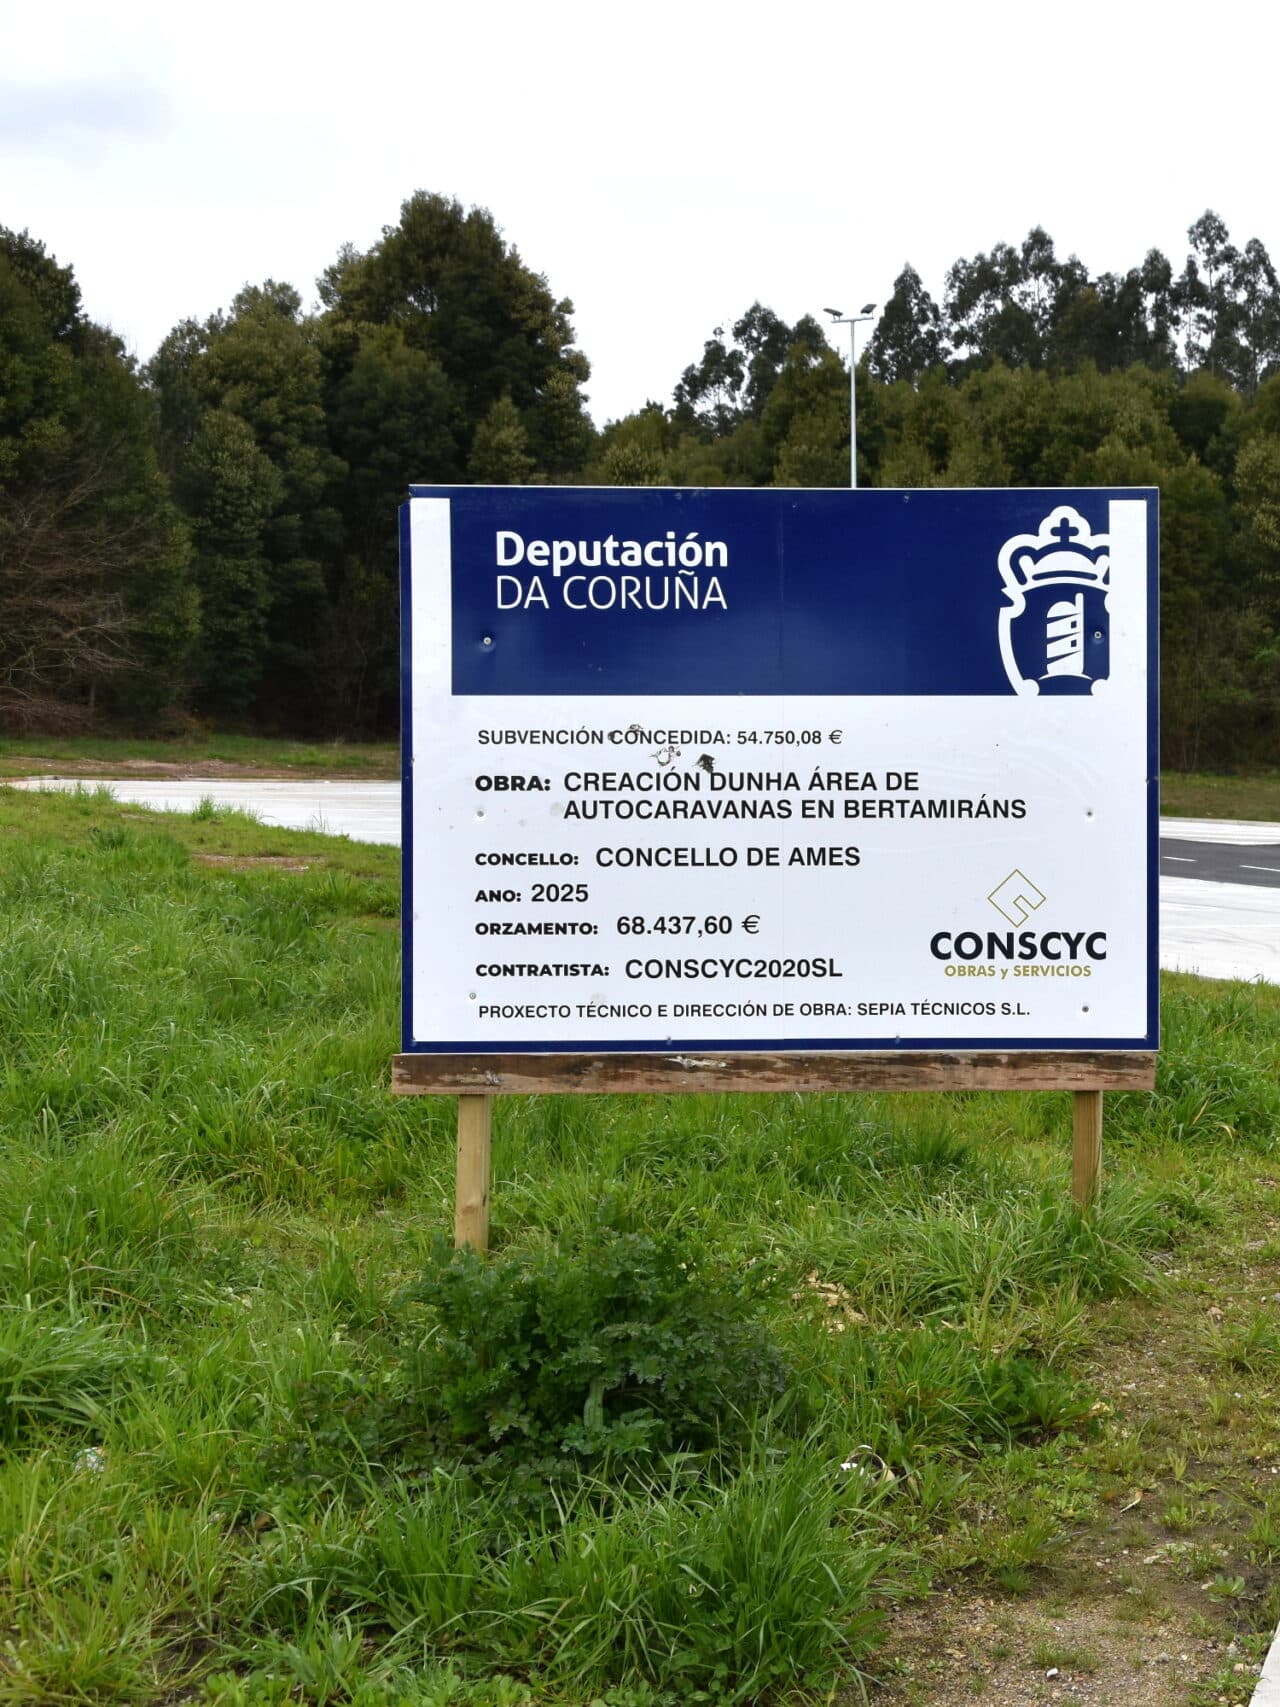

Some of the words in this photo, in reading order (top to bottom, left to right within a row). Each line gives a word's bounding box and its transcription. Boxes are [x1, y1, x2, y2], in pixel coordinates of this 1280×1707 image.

[497, 531, 727, 576] Deputación
[497, 576, 549, 609] DA
[563, 570, 727, 609] CORUÑA
[479, 726, 603, 744] SUBVENCIÓN
[610, 725, 731, 745] CONCEDIDA:
[737, 731, 822, 747] 54.750,08
[829, 730, 842, 744] €
[475, 775, 550, 791] OBRA:
[564, 765, 701, 792] CREACIÓN
[710, 772, 800, 792] DUNHA
[808, 766, 877, 791] ÁREA
[886, 772, 919, 791] DE
[564, 799, 792, 819] AUTOCARAVANAS
[802, 800, 834, 818] EN
[844, 794, 1026, 819] BERTAMIRÁNS
[475, 853, 578, 865] CONCELLO:
[596, 847, 737, 867] CONCELLO
[747, 847, 780, 866] DE
[788, 847, 860, 866] AMES
[475, 890, 521, 902] ANO:
[531, 884, 588, 902] 2025
[475, 922, 598, 935] ORZAMENTO:
[617, 916, 732, 938] 68.437,60
[741, 915, 760, 934] €
[930, 931, 1106, 960] CONSCYC
[476, 964, 609, 977] CONTRATISTA:
[626, 958, 842, 979] CONSCYC2020SL
[945, 965, 995, 976] OBRAS
[1000, 968, 1010, 980] y
[1014, 966, 1091, 976] SERVICIOS
[479, 1005, 570, 1018] PROXECTO
[576, 1001, 652, 1017] TÉCNICO
[658, 1005, 667, 1017] E
[674, 1000, 766, 1017] DIRECCIÓN
[773, 1004, 794, 1016] DE
[800, 1003, 851, 1016] OBRA:
[858, 1002, 906, 1016] SEPIA
[909, 998, 996, 1016] TÉCNICOS
[1001, 1003, 1030, 1015] S.L.
